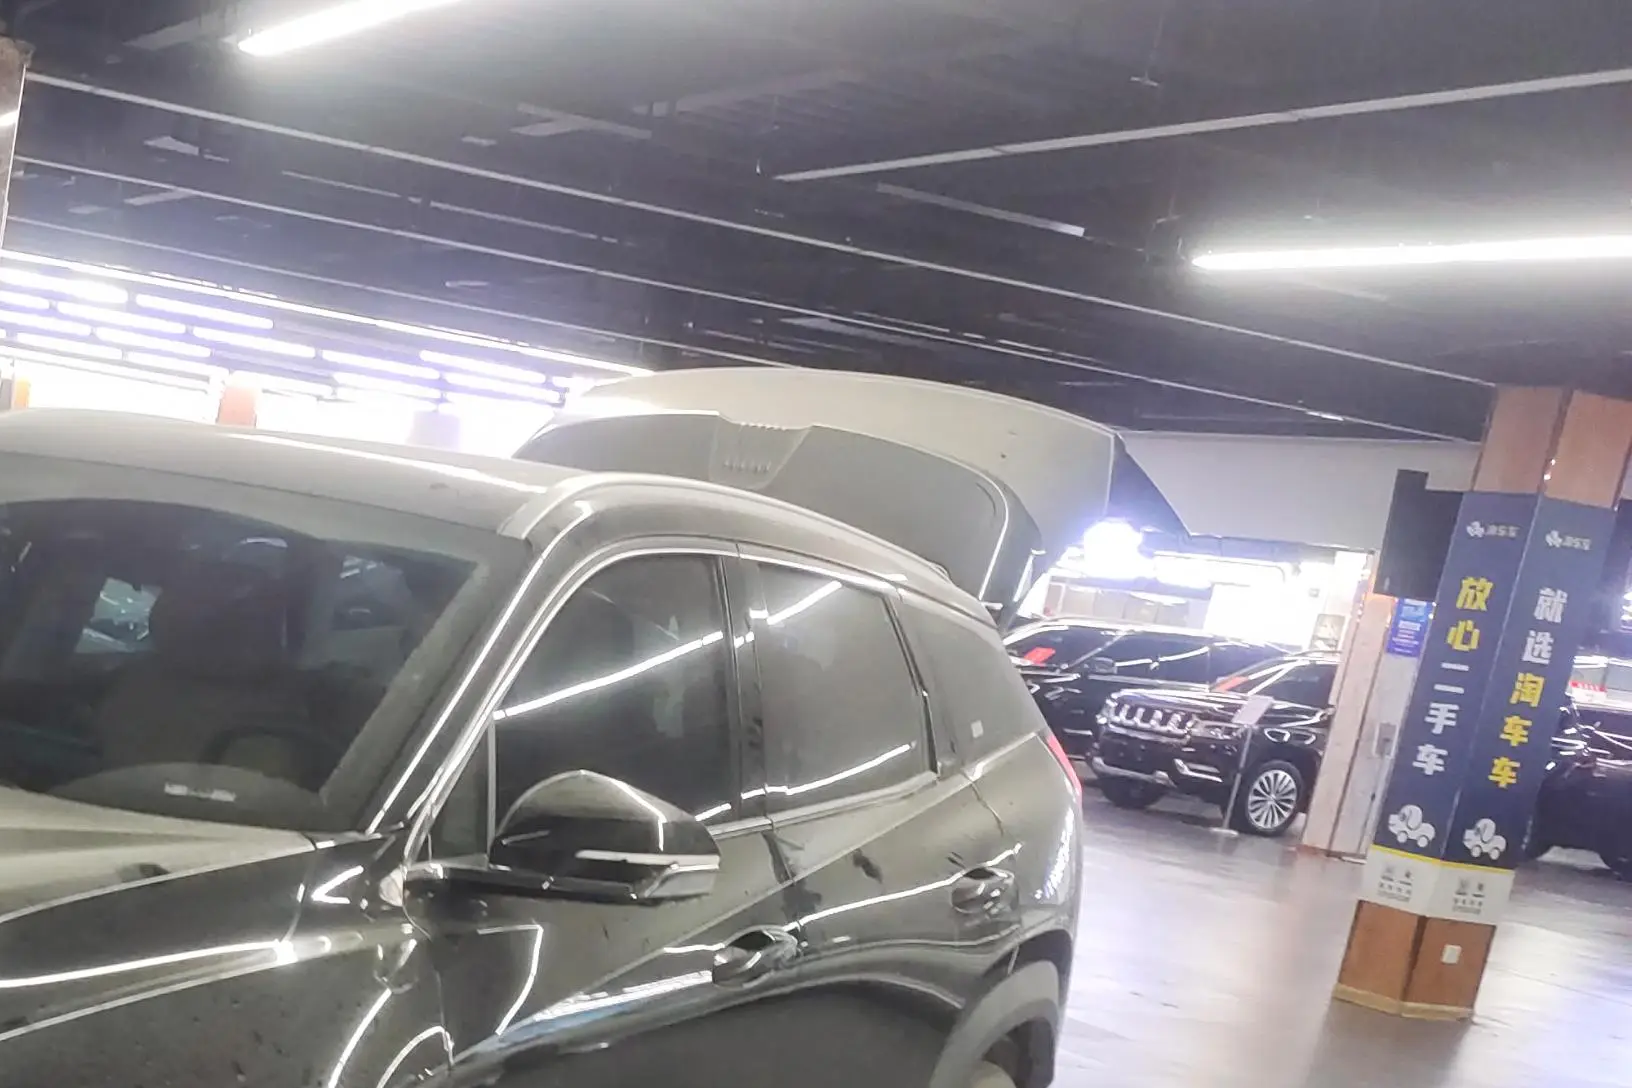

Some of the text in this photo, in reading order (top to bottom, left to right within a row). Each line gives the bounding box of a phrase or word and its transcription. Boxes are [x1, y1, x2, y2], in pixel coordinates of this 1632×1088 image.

[1412, 576, 1494, 775] 放心二手车
[1488, 587, 1568, 789] 就选淘车车
